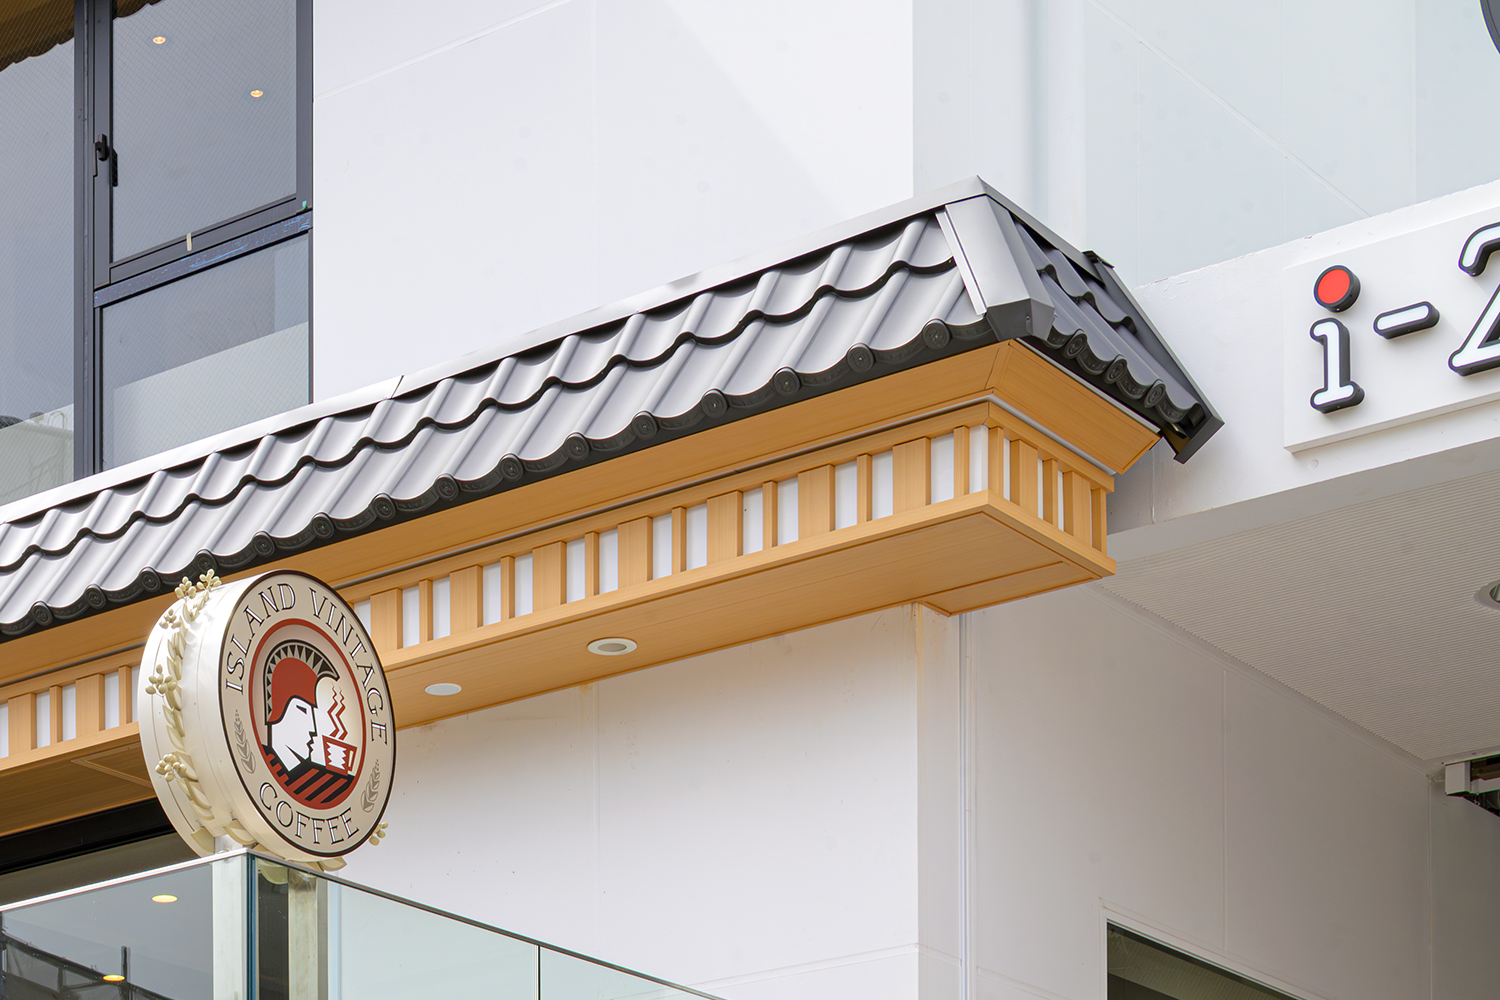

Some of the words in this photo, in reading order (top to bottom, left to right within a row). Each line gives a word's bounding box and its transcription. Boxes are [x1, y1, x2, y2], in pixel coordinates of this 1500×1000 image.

[225, 582, 297, 695] ISLAND
[308, 586, 389, 746] VINTAGE
[258, 780, 361, 845] COFFEE
